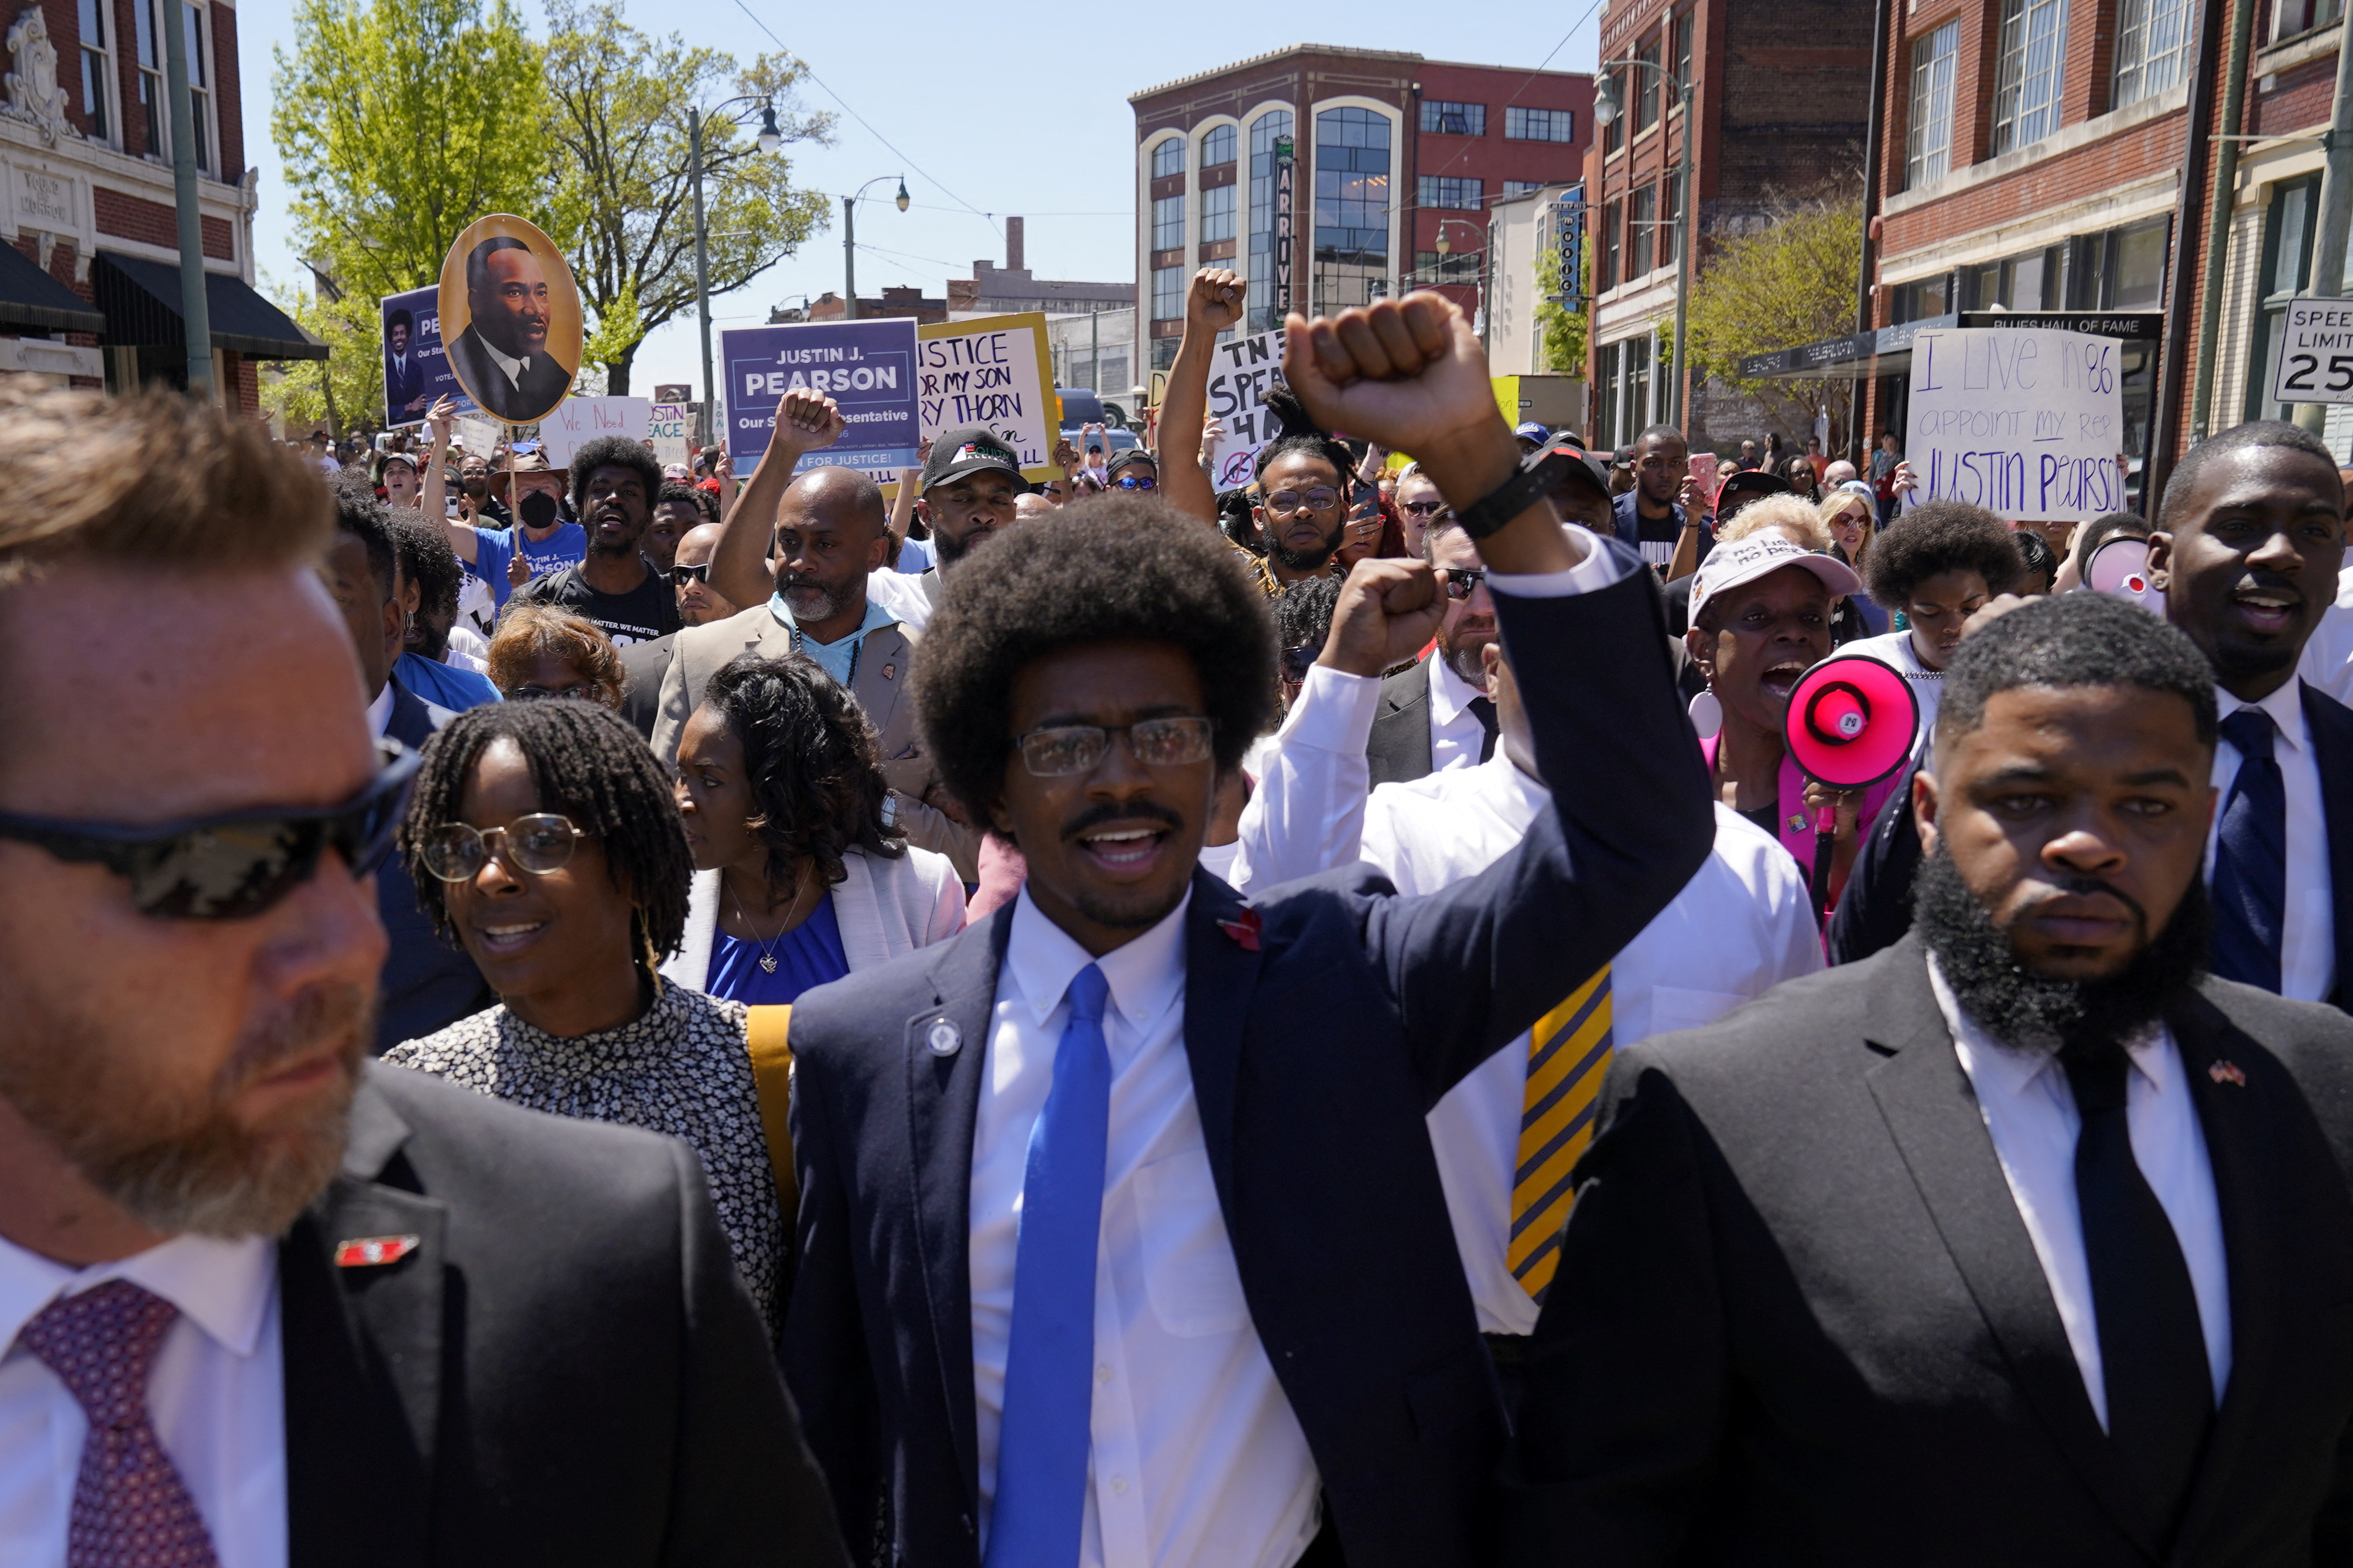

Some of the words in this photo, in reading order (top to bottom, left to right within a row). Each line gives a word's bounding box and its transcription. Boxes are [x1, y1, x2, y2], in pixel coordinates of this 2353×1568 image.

[1278, 169, 1291, 309] ARRIVE
[2079, 320, 2099, 333] OF
[2102, 320, 2139, 333] FAME
[1222, 336, 1269, 368] TN
[2298, 333, 2353, 349] LIMIT
[418, 349, 430, 358] Our
[777, 348, 843, 365] JUSTIN
[849, 347, 864, 360] J.
[1916, 334, 1944, 392] I
[2085, 343, 2113, 394] 86
[745, 366, 897, 396] PEARSON
[944, 371, 970, 393] MY
[974, 367, 1011, 389] SON
[2284, 354, 2353, 391] 25
[559, 404, 581, 431] We
[594, 404, 627, 430] Need
[952, 393, 1022, 424] THORN
[738, 417, 764, 429] Our
[1233, 413, 1257, 446] 4
[807, 457, 832, 467] FOR
[837, 454, 891, 465] JUSTICE!
[1733, 546, 1756, 557] no
[1738, 552, 1762, 566] no
[632, 626, 659, 636] MATTER.
